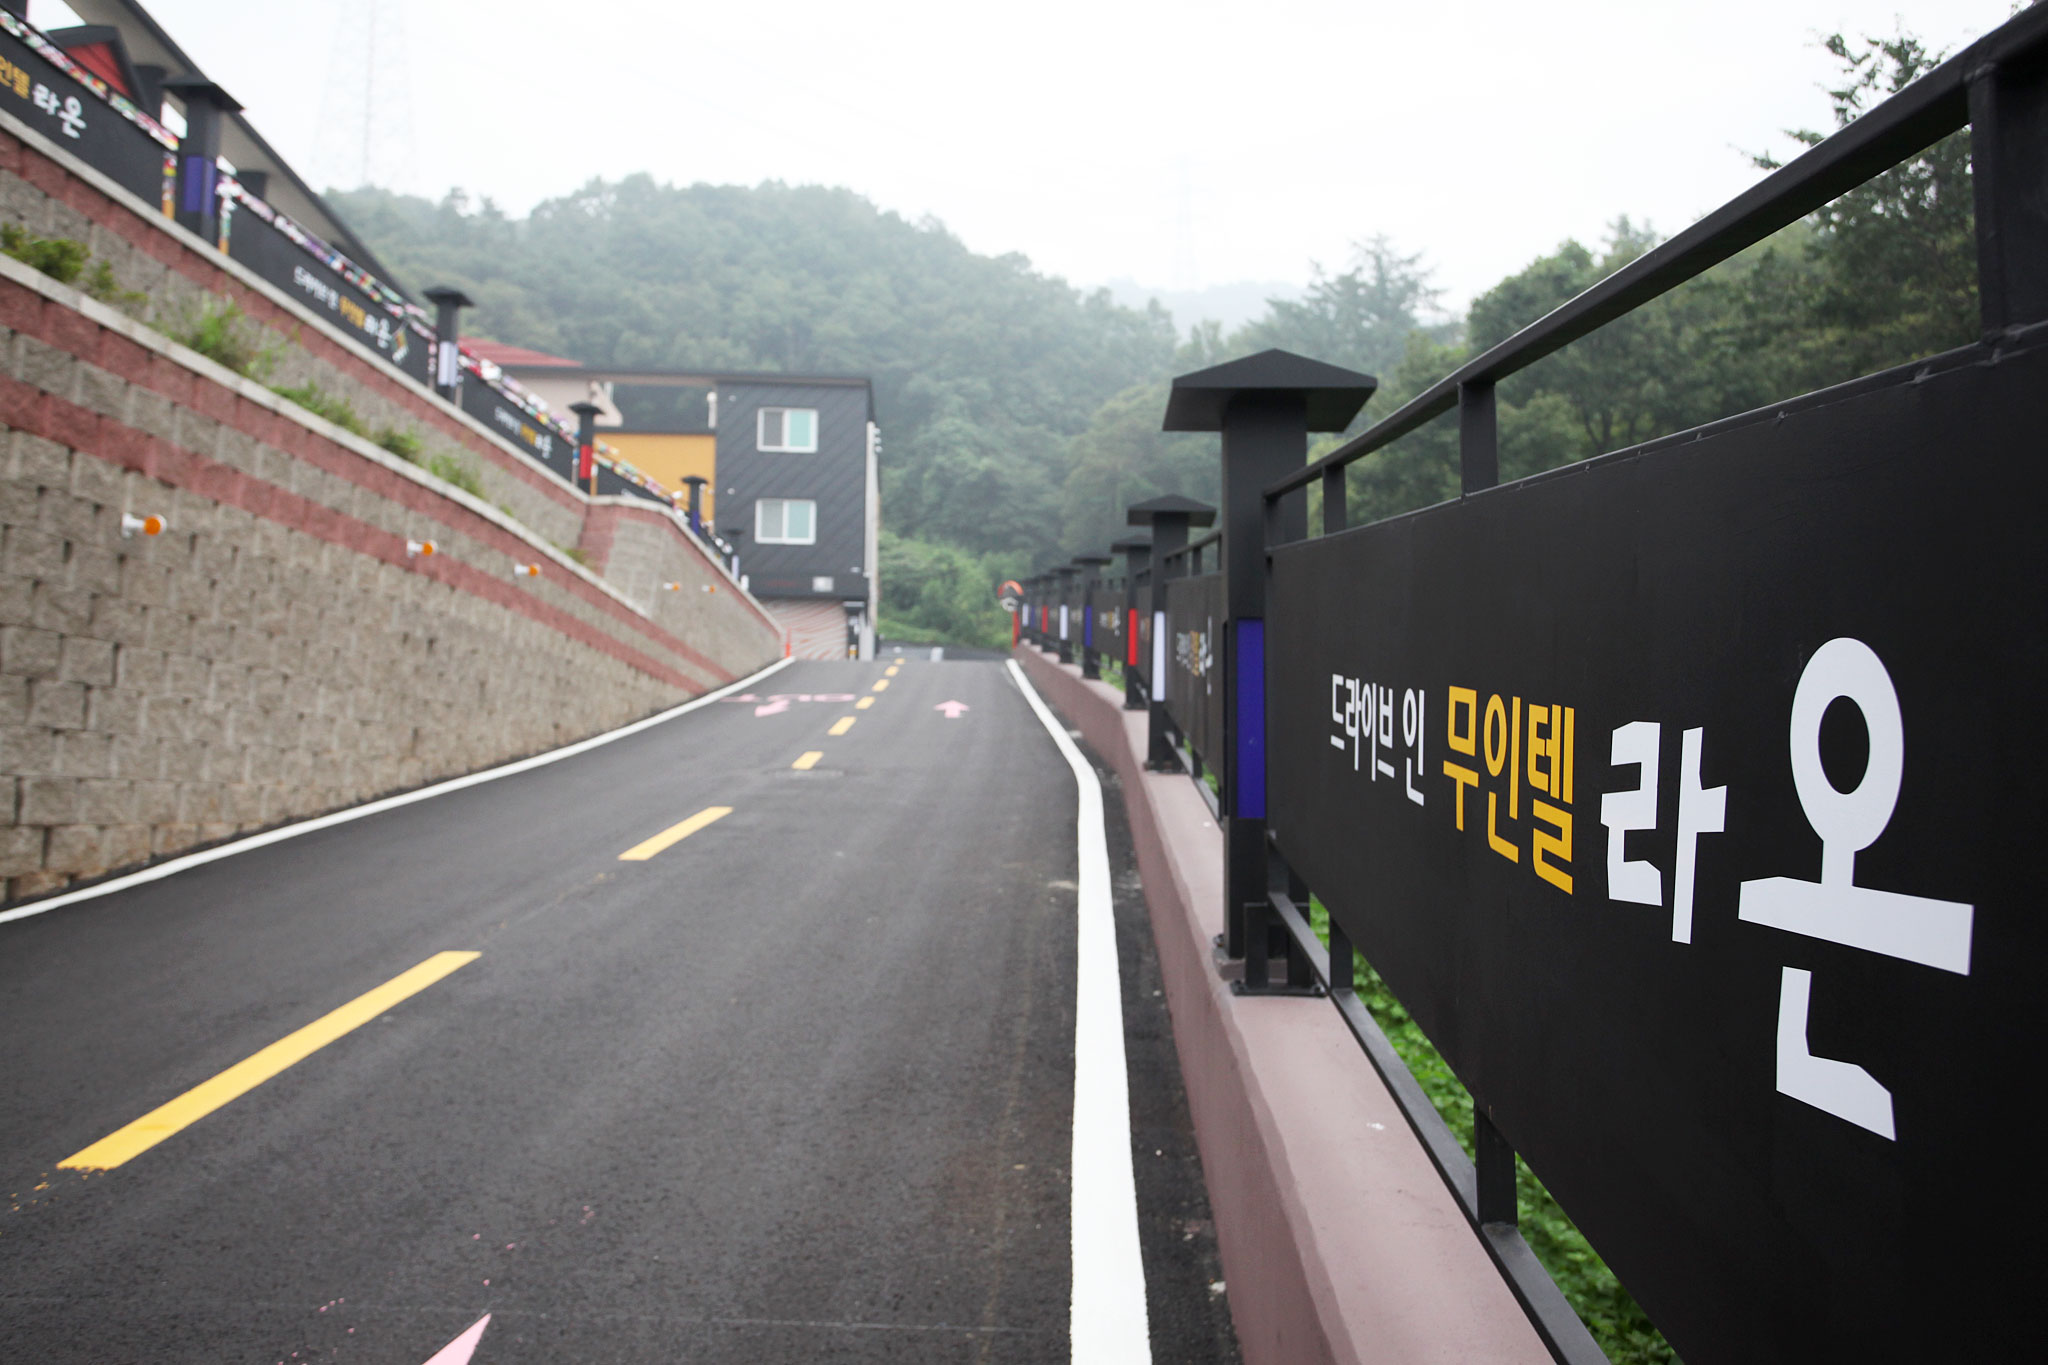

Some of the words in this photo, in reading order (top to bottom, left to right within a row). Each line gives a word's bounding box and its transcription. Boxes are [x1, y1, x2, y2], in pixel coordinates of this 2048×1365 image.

[1330, 673, 1395, 782] 드라이브
[1402, 688, 1425, 807] 인
[1443, 685, 1575, 895] 무인텔
[1600, 637, 1974, 1142] 라온
